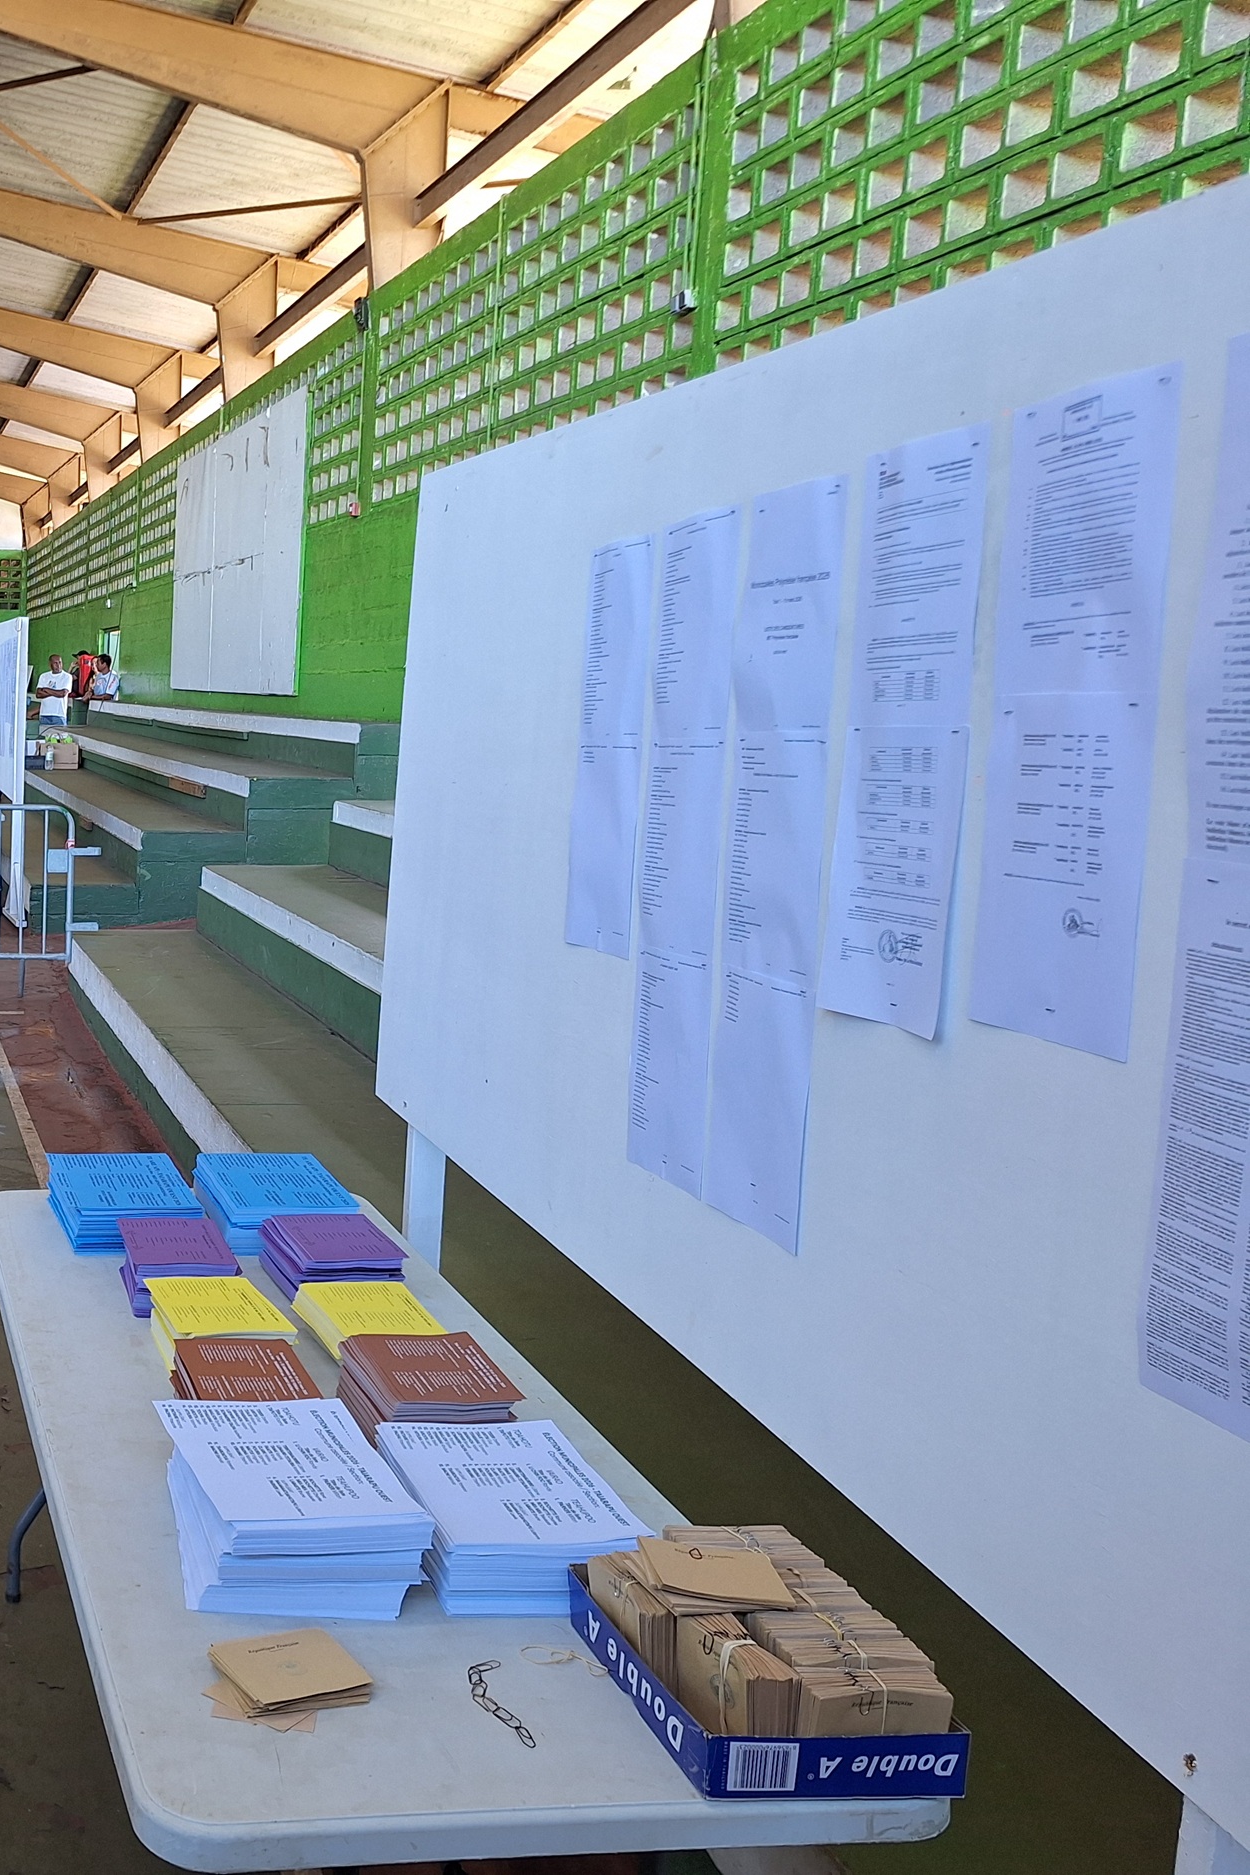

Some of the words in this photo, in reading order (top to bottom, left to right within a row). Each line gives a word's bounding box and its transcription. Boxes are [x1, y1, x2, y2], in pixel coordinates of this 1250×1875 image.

[607, 1636, 684, 1753] Double
[818, 1756, 842, 1778] A
[851, 1753, 959, 1777] Double
